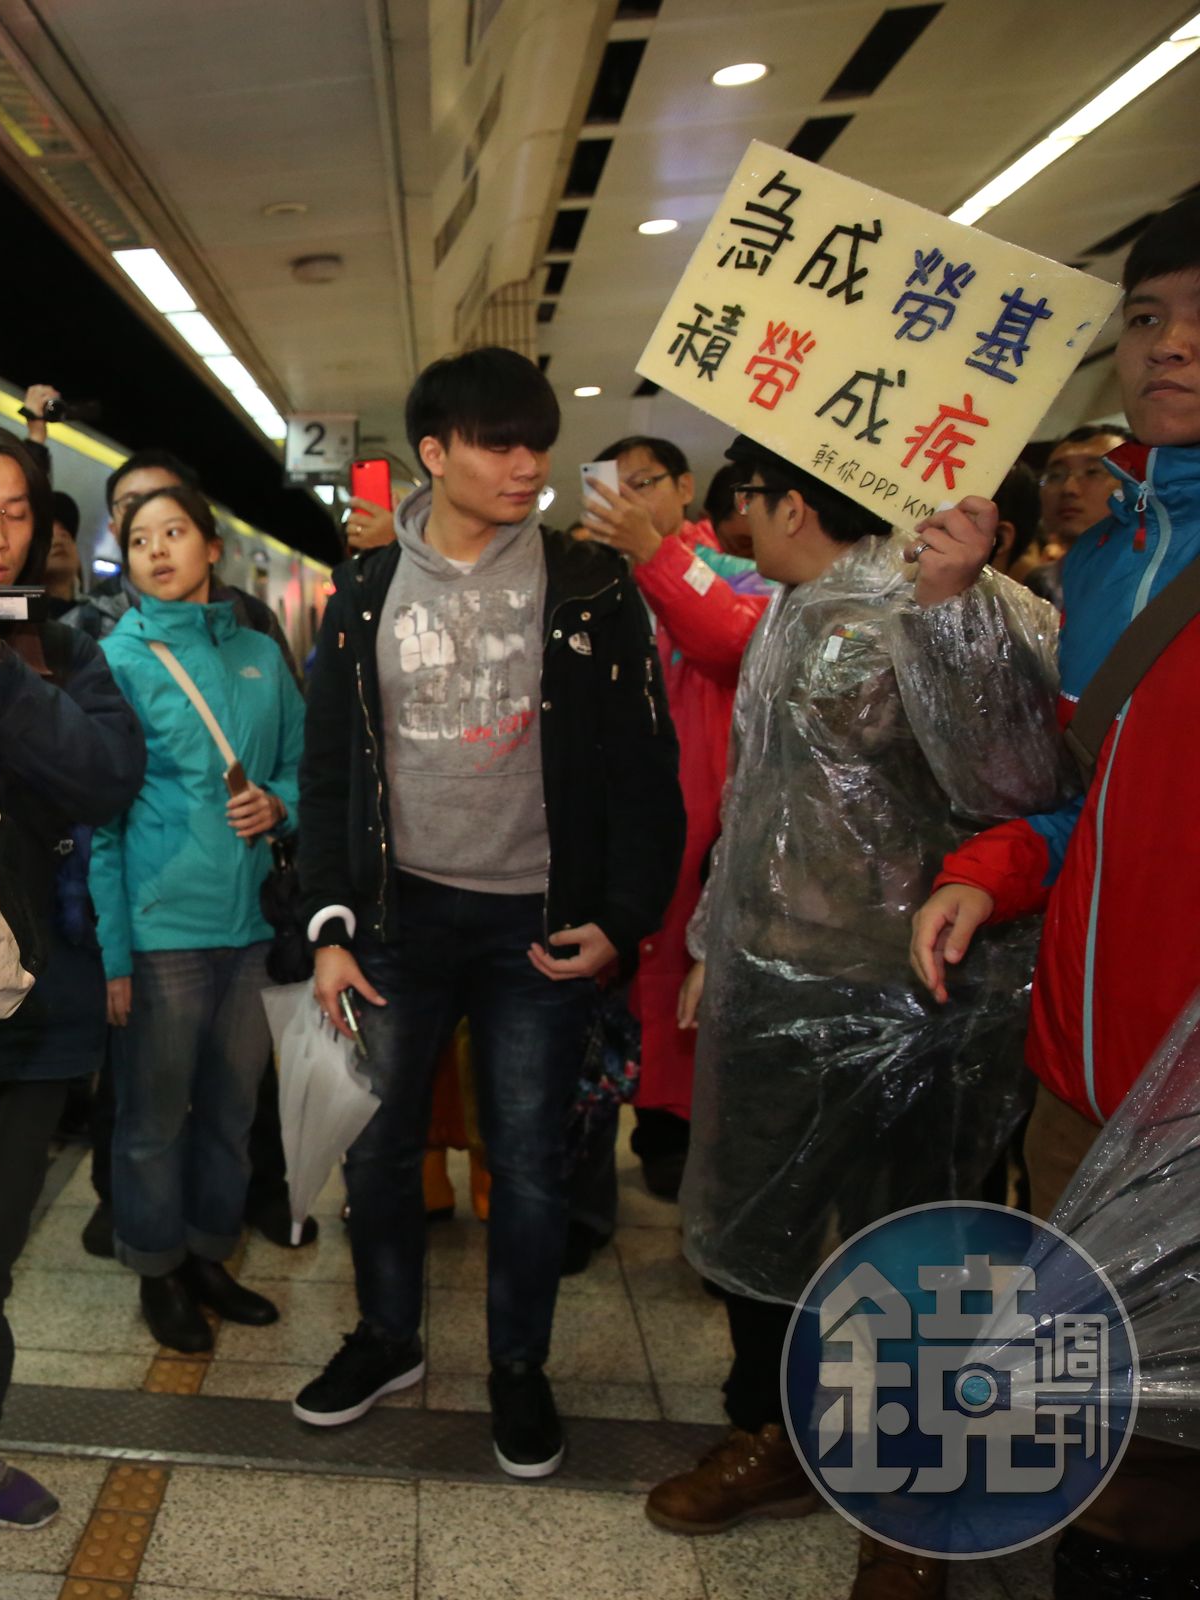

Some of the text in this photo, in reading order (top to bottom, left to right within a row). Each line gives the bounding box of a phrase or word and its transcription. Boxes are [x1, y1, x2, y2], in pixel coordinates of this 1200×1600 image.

[303, 422, 326, 456] 2
[668, 302, 990, 490] 積勞成疾
